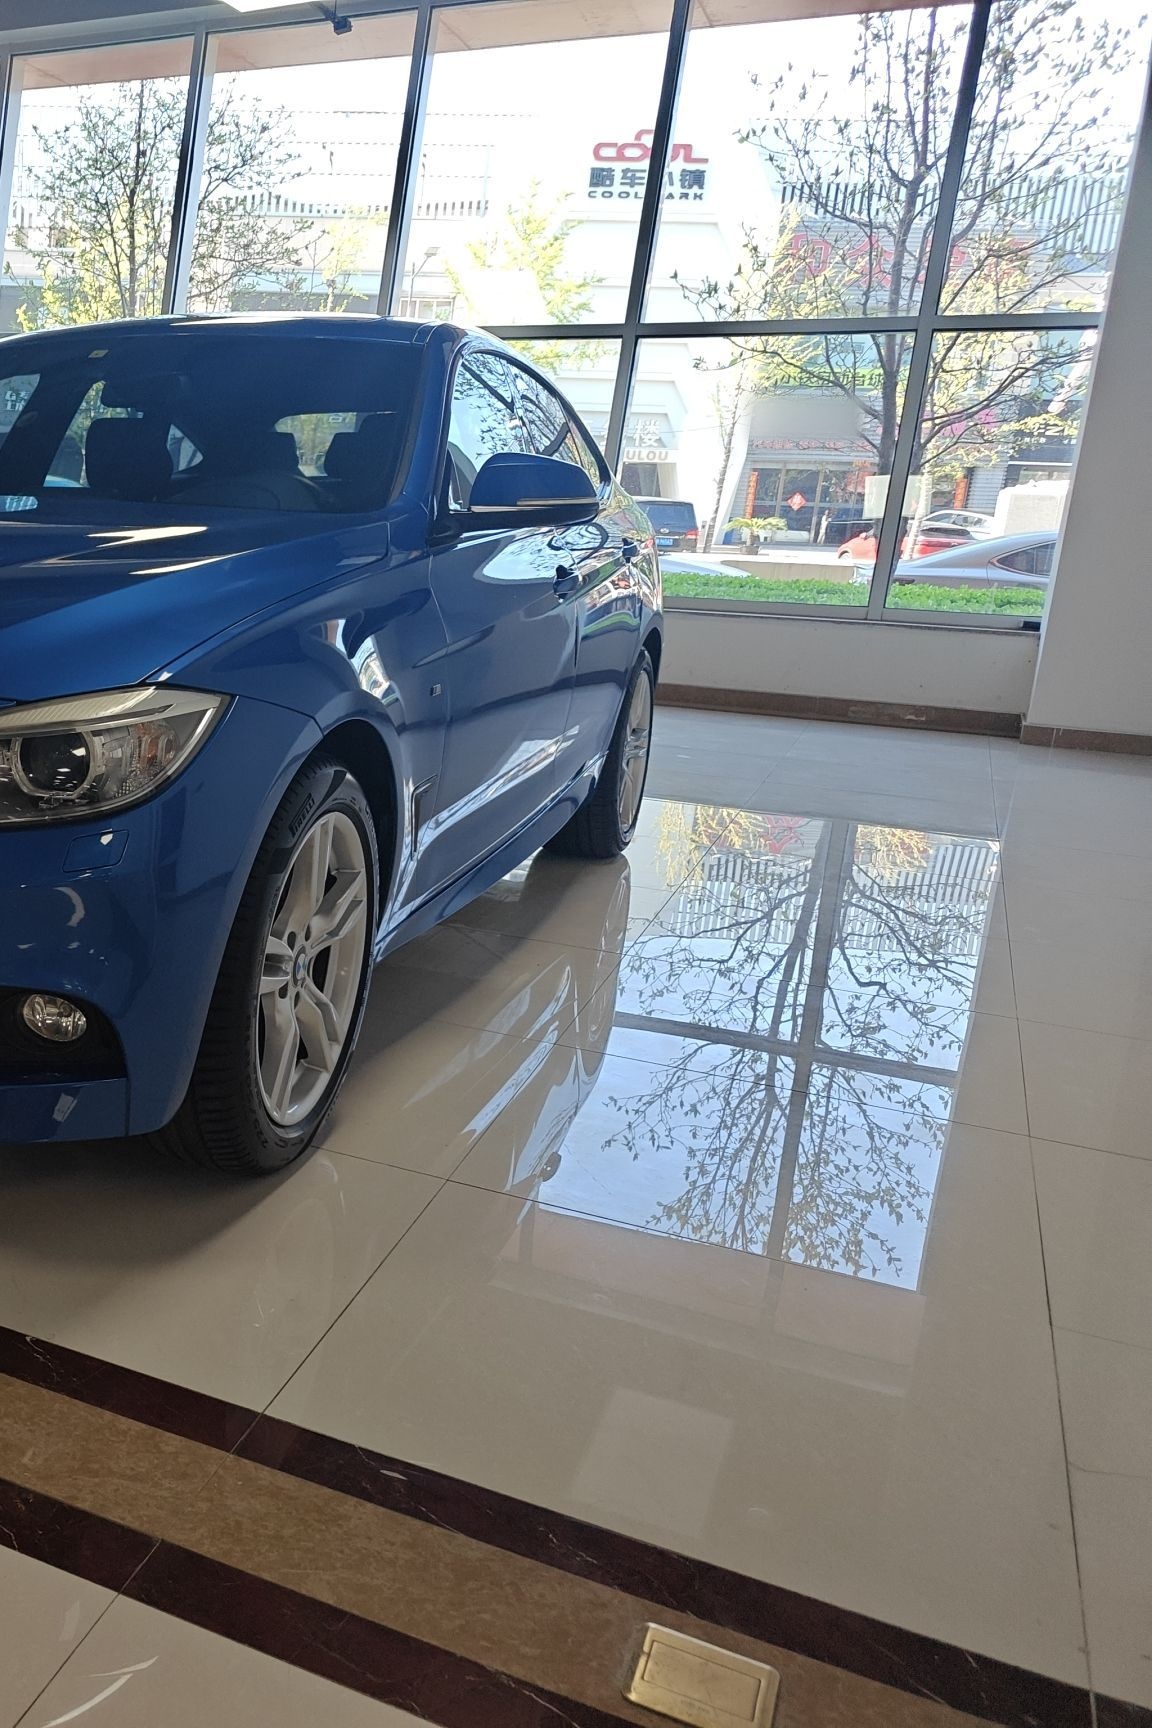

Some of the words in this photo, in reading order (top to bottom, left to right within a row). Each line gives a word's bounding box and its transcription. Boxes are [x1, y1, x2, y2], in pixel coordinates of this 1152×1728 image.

[593, 141, 709, 163] COL
[589, 167, 706, 189] 酷车镇
[588, 190, 704, 200] COOLARK
[288, 792, 315, 838] PIRELLI
